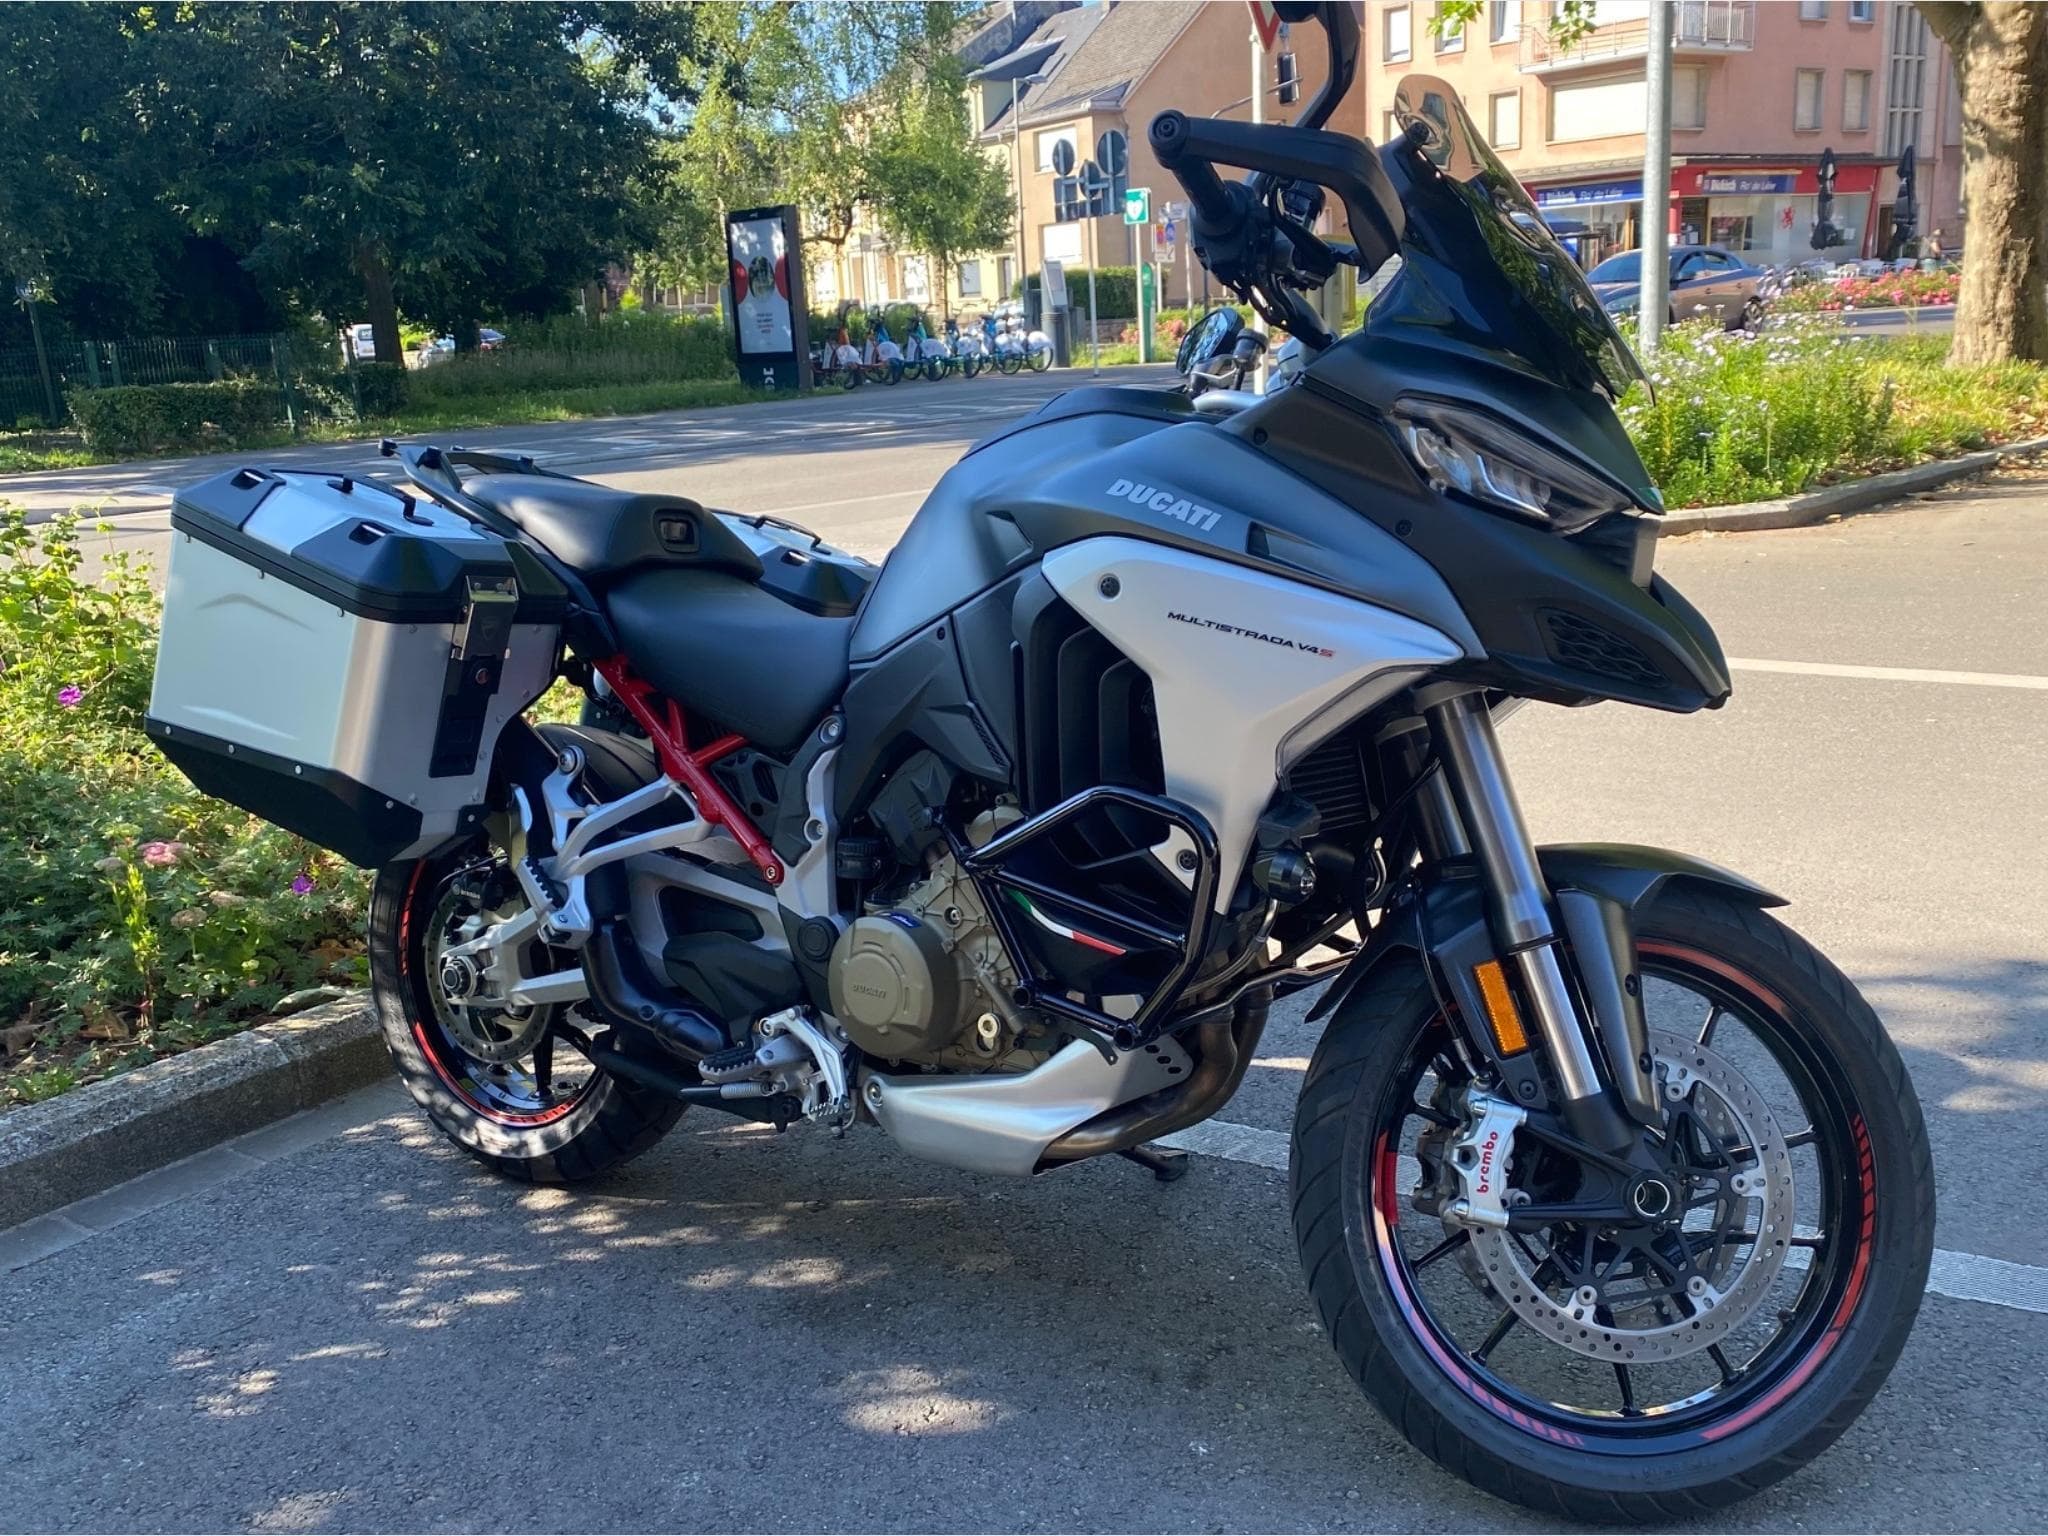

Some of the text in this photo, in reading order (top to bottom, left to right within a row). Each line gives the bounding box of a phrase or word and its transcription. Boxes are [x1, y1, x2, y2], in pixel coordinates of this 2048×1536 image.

[1106, 478, 1222, 532] DUCATI
[1167, 611, 1335, 658] MULTISTRADA V4S
[1476, 1131, 1500, 1194] brembo
